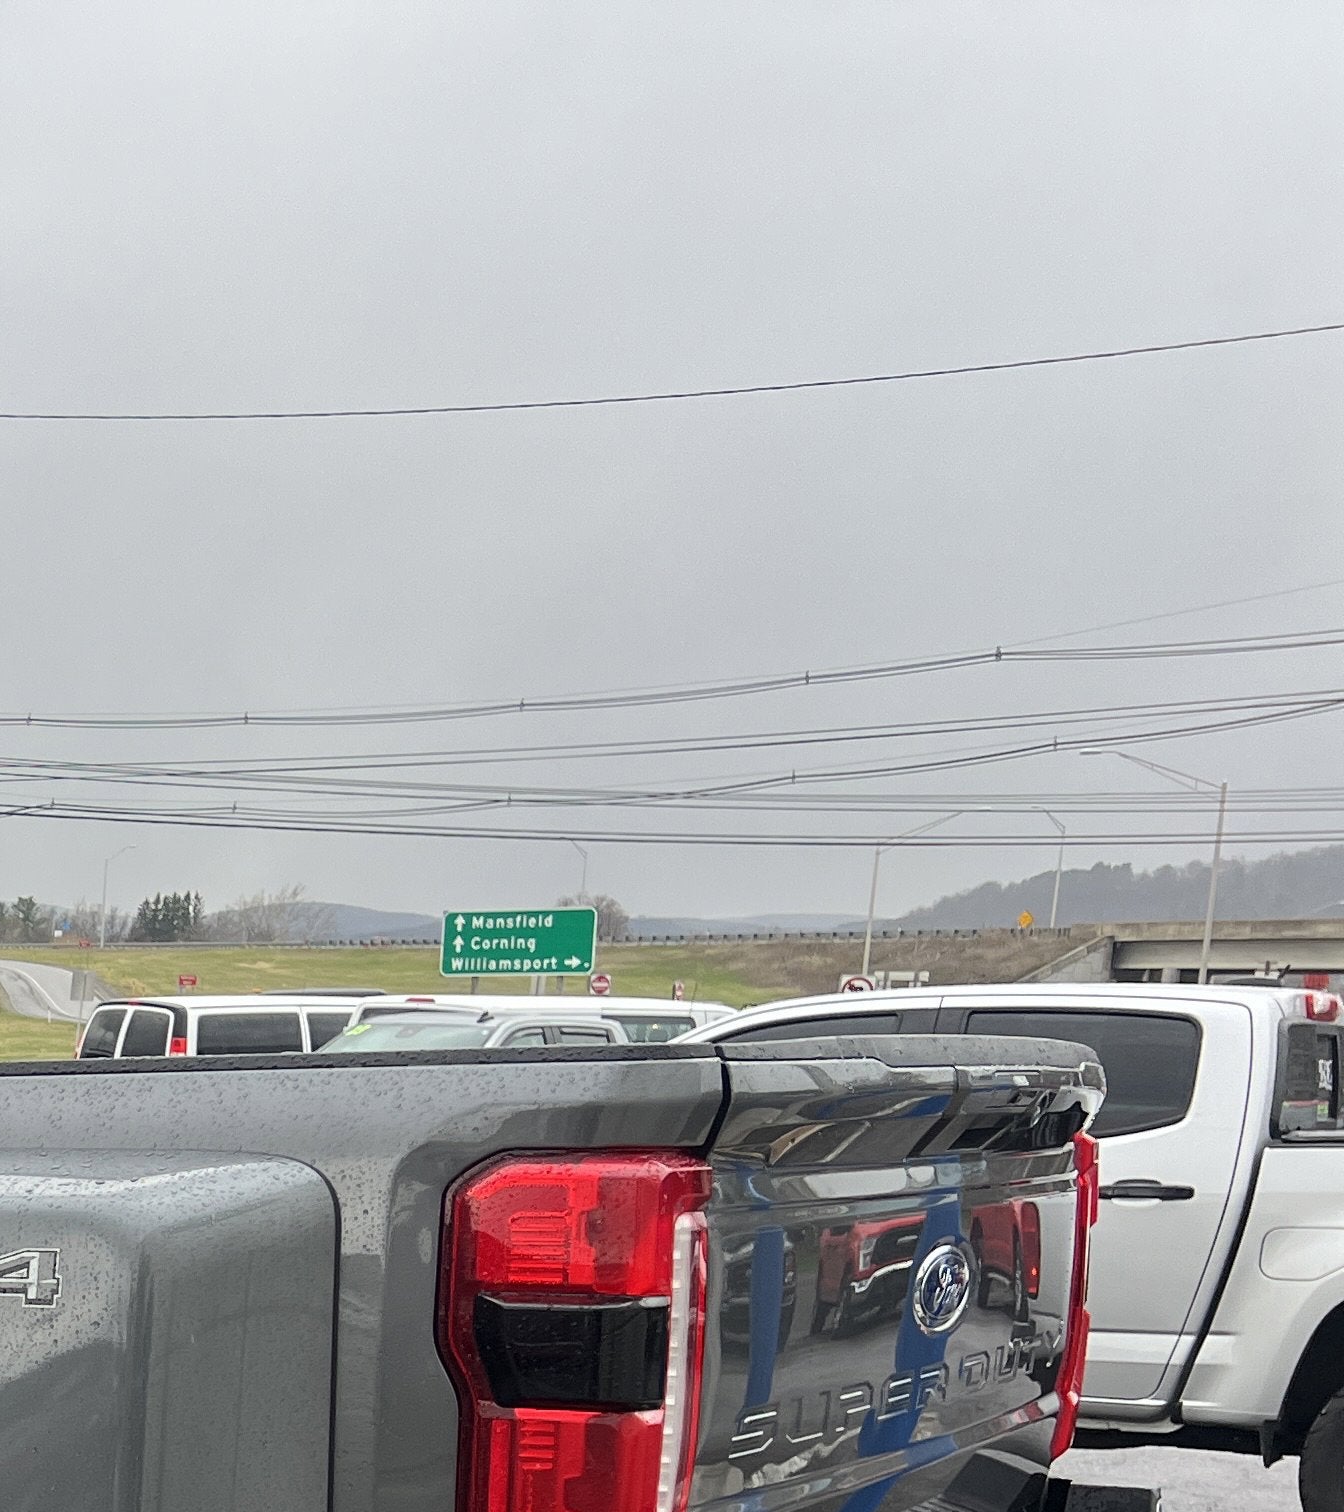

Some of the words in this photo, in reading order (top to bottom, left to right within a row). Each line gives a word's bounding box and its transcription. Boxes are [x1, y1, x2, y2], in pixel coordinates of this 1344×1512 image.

[472, 914, 553, 929] Mansfield
[471, 936, 536, 952] Corning
[451, 956, 557, 971] Williamsport
[728, 1362, 949, 1460] SUPER
[960, 1330, 1063, 1389] DUTY
